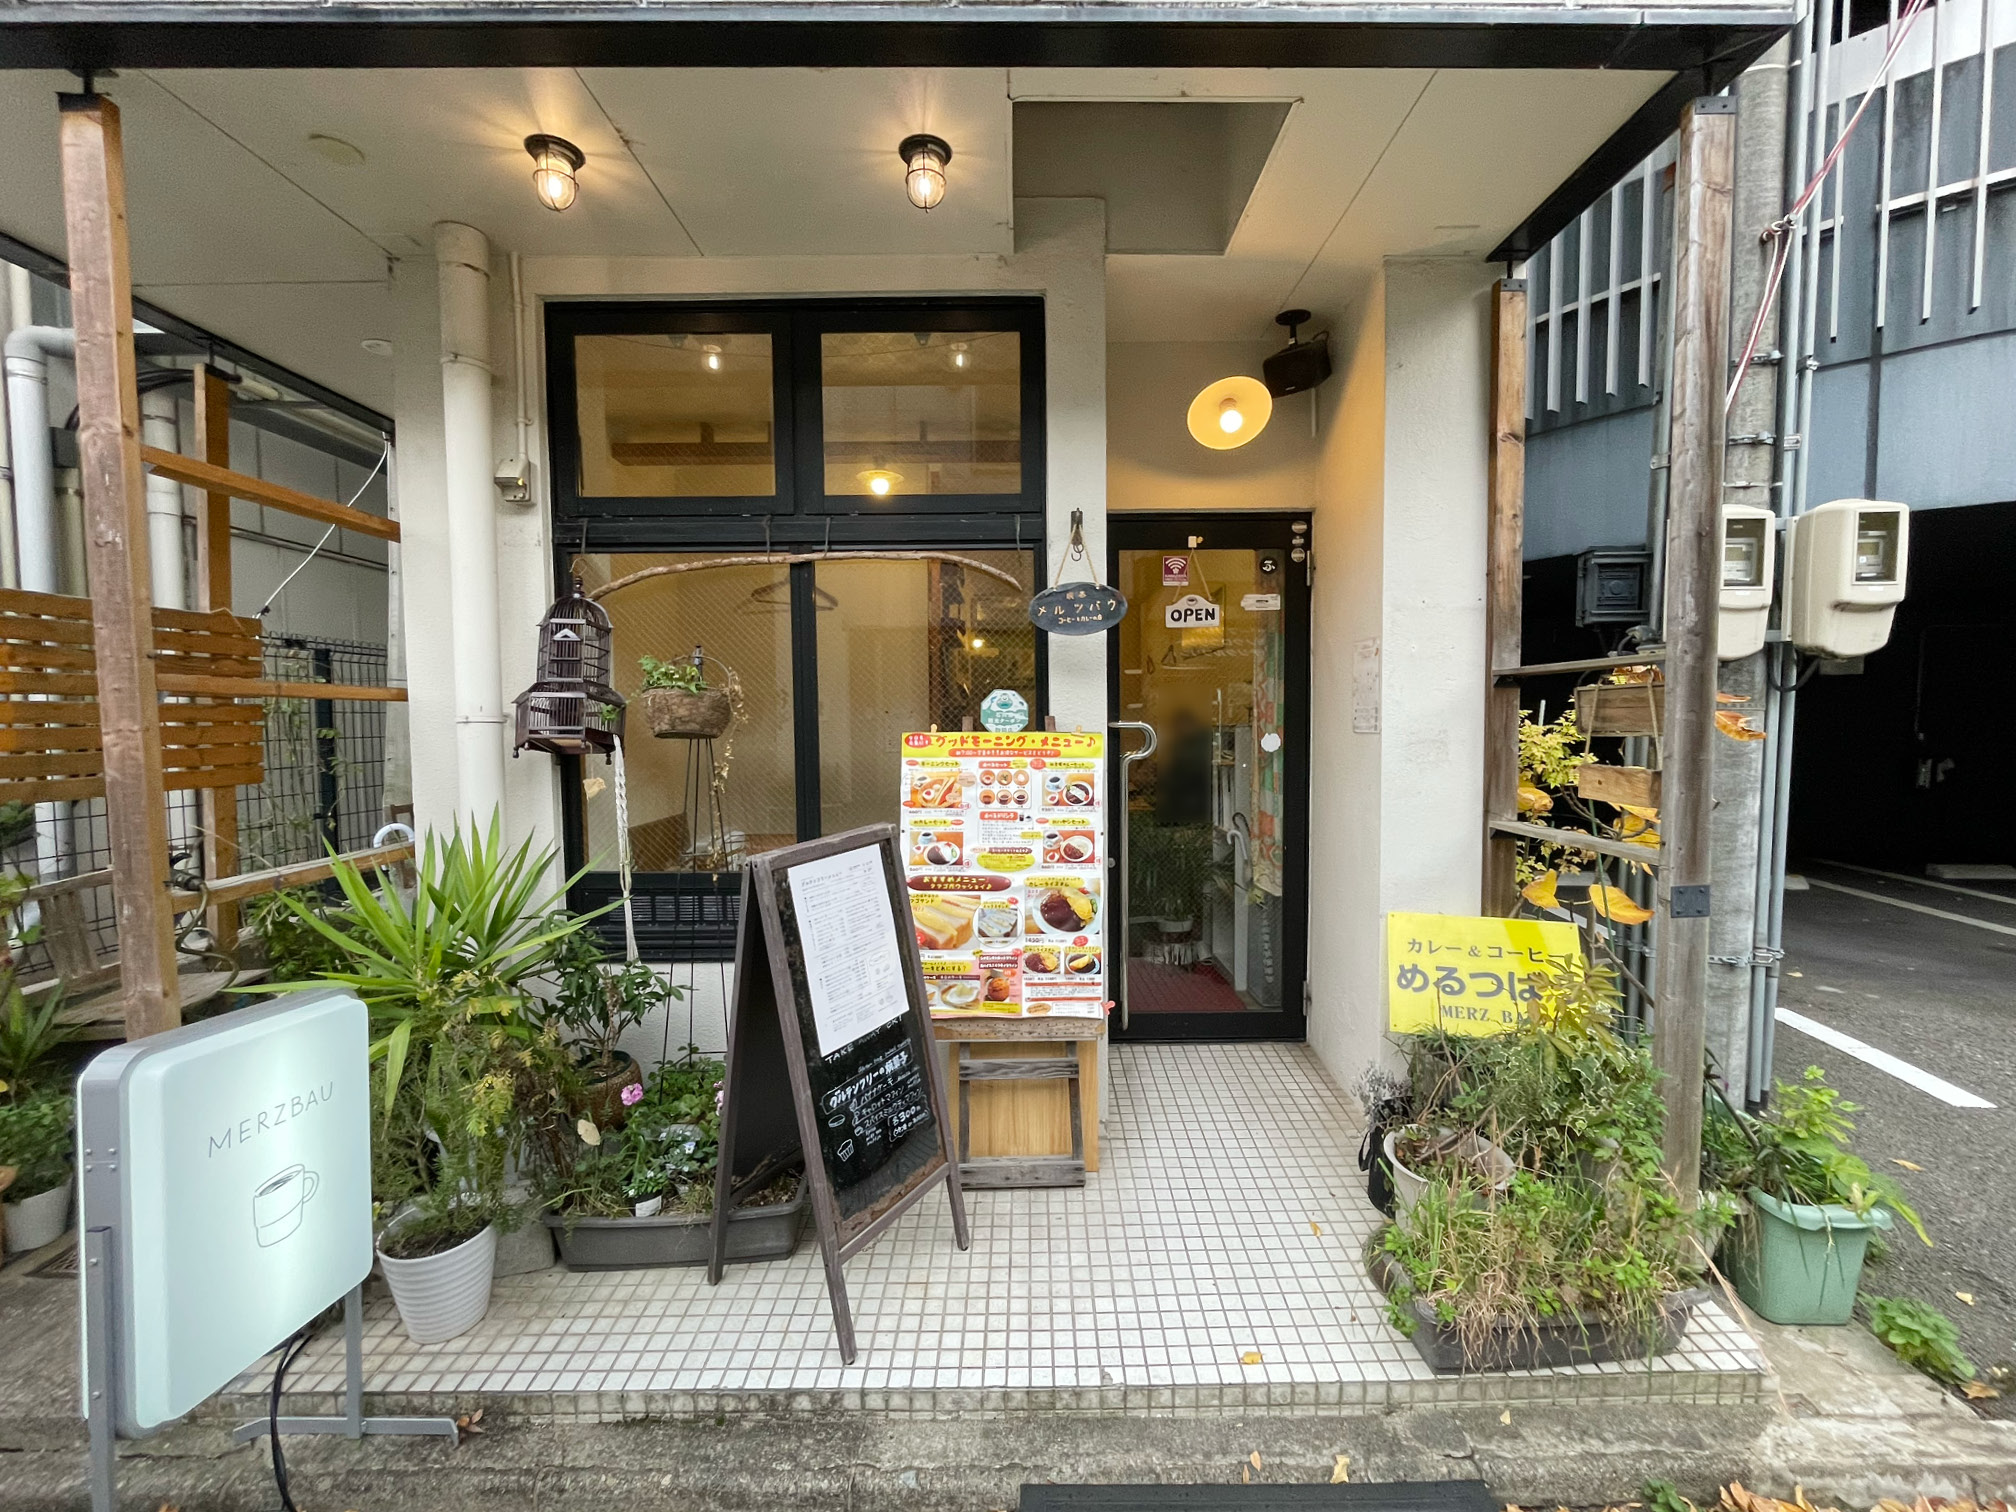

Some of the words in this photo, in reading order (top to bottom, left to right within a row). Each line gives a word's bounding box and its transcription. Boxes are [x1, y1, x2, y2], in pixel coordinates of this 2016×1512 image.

[1037, 598, 1116, 617] メルツバウ
[1170, 607, 1216, 623] OPEN
[935, 734, 1084, 748] グッドモーニング・メニュー
[923, 875, 986, 883] おすすめメニュー
[1441, 1004, 1490, 1022] MERZ
[824, 1043, 854, 1064] TAKE
[829, 1051, 909, 1109] グルテンフリーの焼菓子
[861, 1077, 893, 1105] バナナケーキ
[862, 1085, 904, 1116] キャロットマフィン
[207, 1081, 334, 1159] MERZBAU
